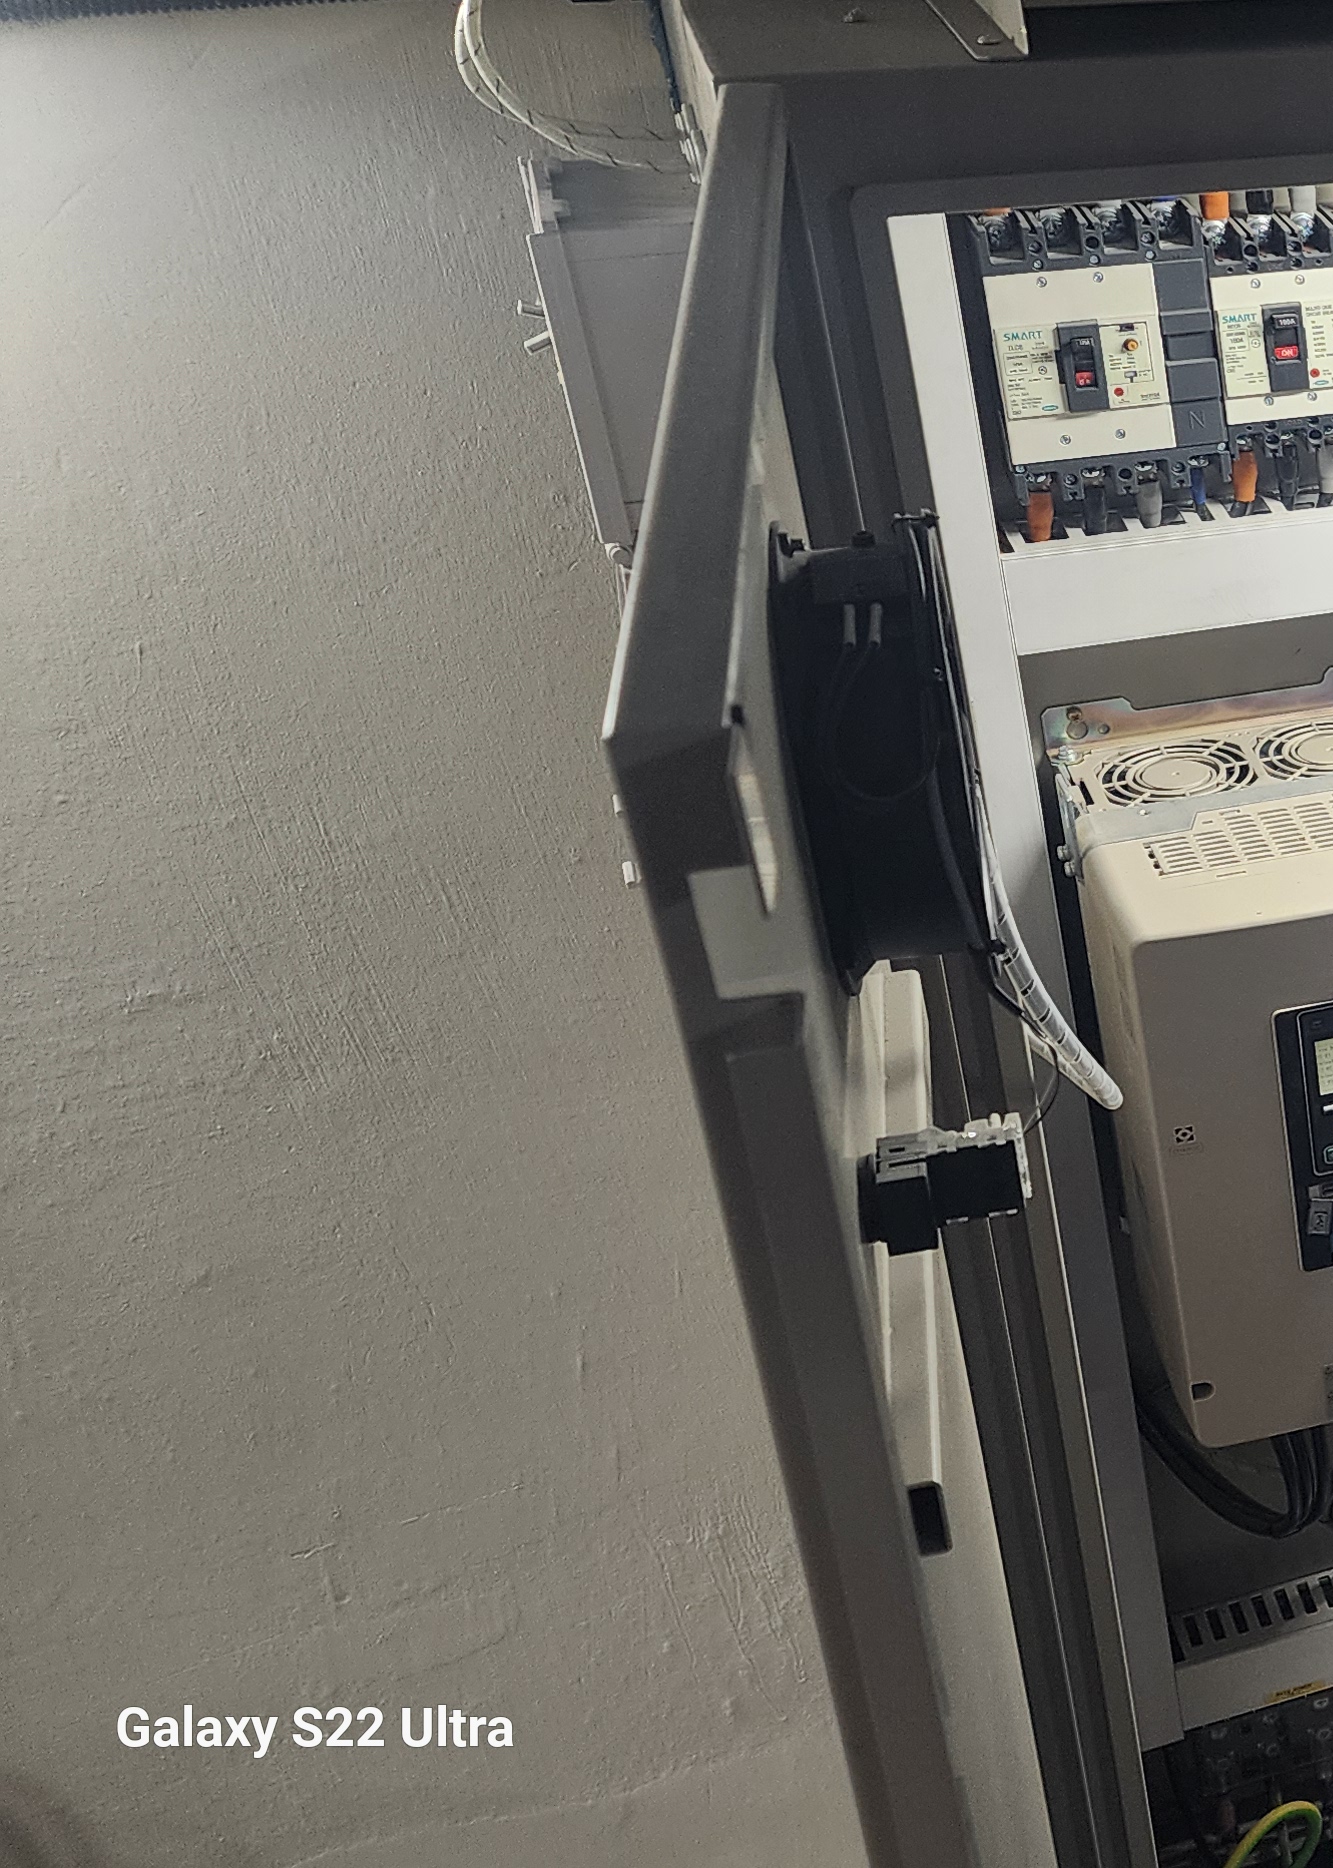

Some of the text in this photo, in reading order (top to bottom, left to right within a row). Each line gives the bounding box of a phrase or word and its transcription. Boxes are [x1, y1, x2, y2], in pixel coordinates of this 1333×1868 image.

[1222, 313, 1257, 324] SMART
[1003, 330, 1043, 342] SMART
[1281, 348, 1294, 356] ON
